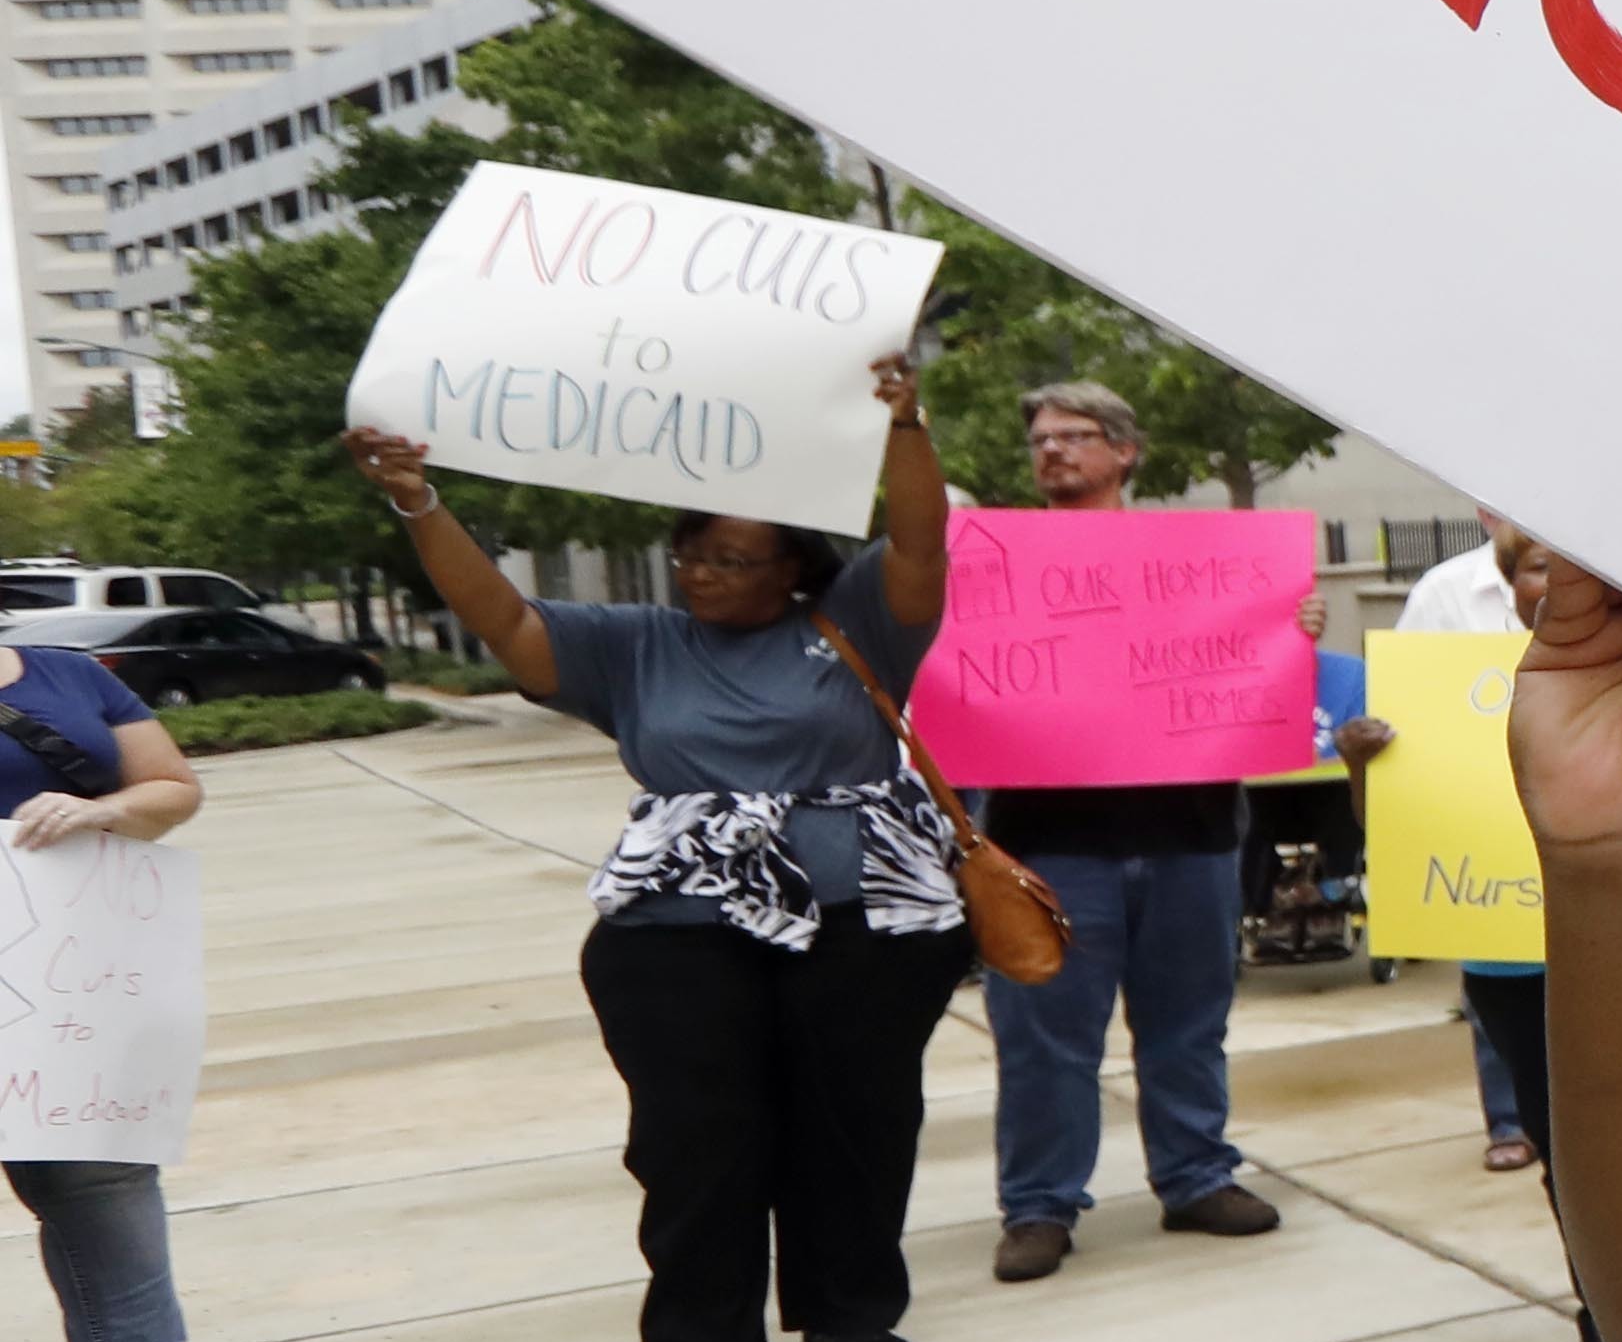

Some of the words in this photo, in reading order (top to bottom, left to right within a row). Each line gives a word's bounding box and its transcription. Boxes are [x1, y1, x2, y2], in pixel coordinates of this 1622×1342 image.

[479, 190, 656, 287] NO
[682, 213, 889, 324] CUTS
[598, 316, 672, 372] to
[425, 358, 764, 481] MEDICAID
[957, 633, 1068, 706] NOT
[1422, 854, 1543, 908] Nurs
[51, 1012, 96, 1044] to
